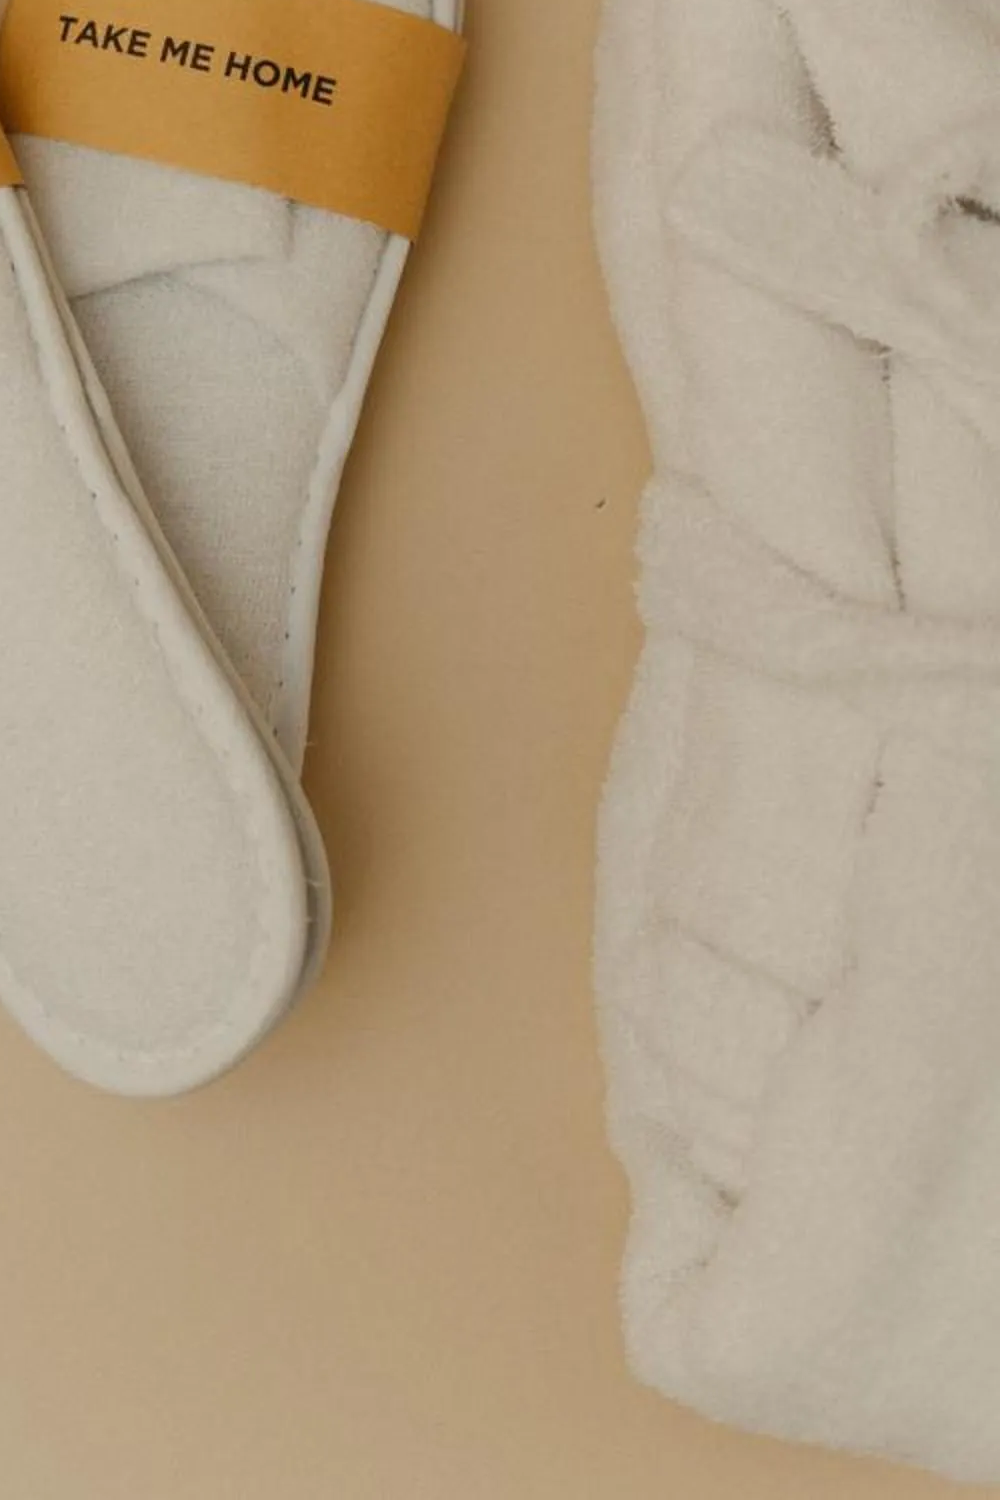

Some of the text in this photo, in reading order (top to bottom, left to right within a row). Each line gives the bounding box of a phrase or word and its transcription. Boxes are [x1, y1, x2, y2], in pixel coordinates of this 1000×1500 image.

[58, 14, 339, 108] TAKE ME HOME
